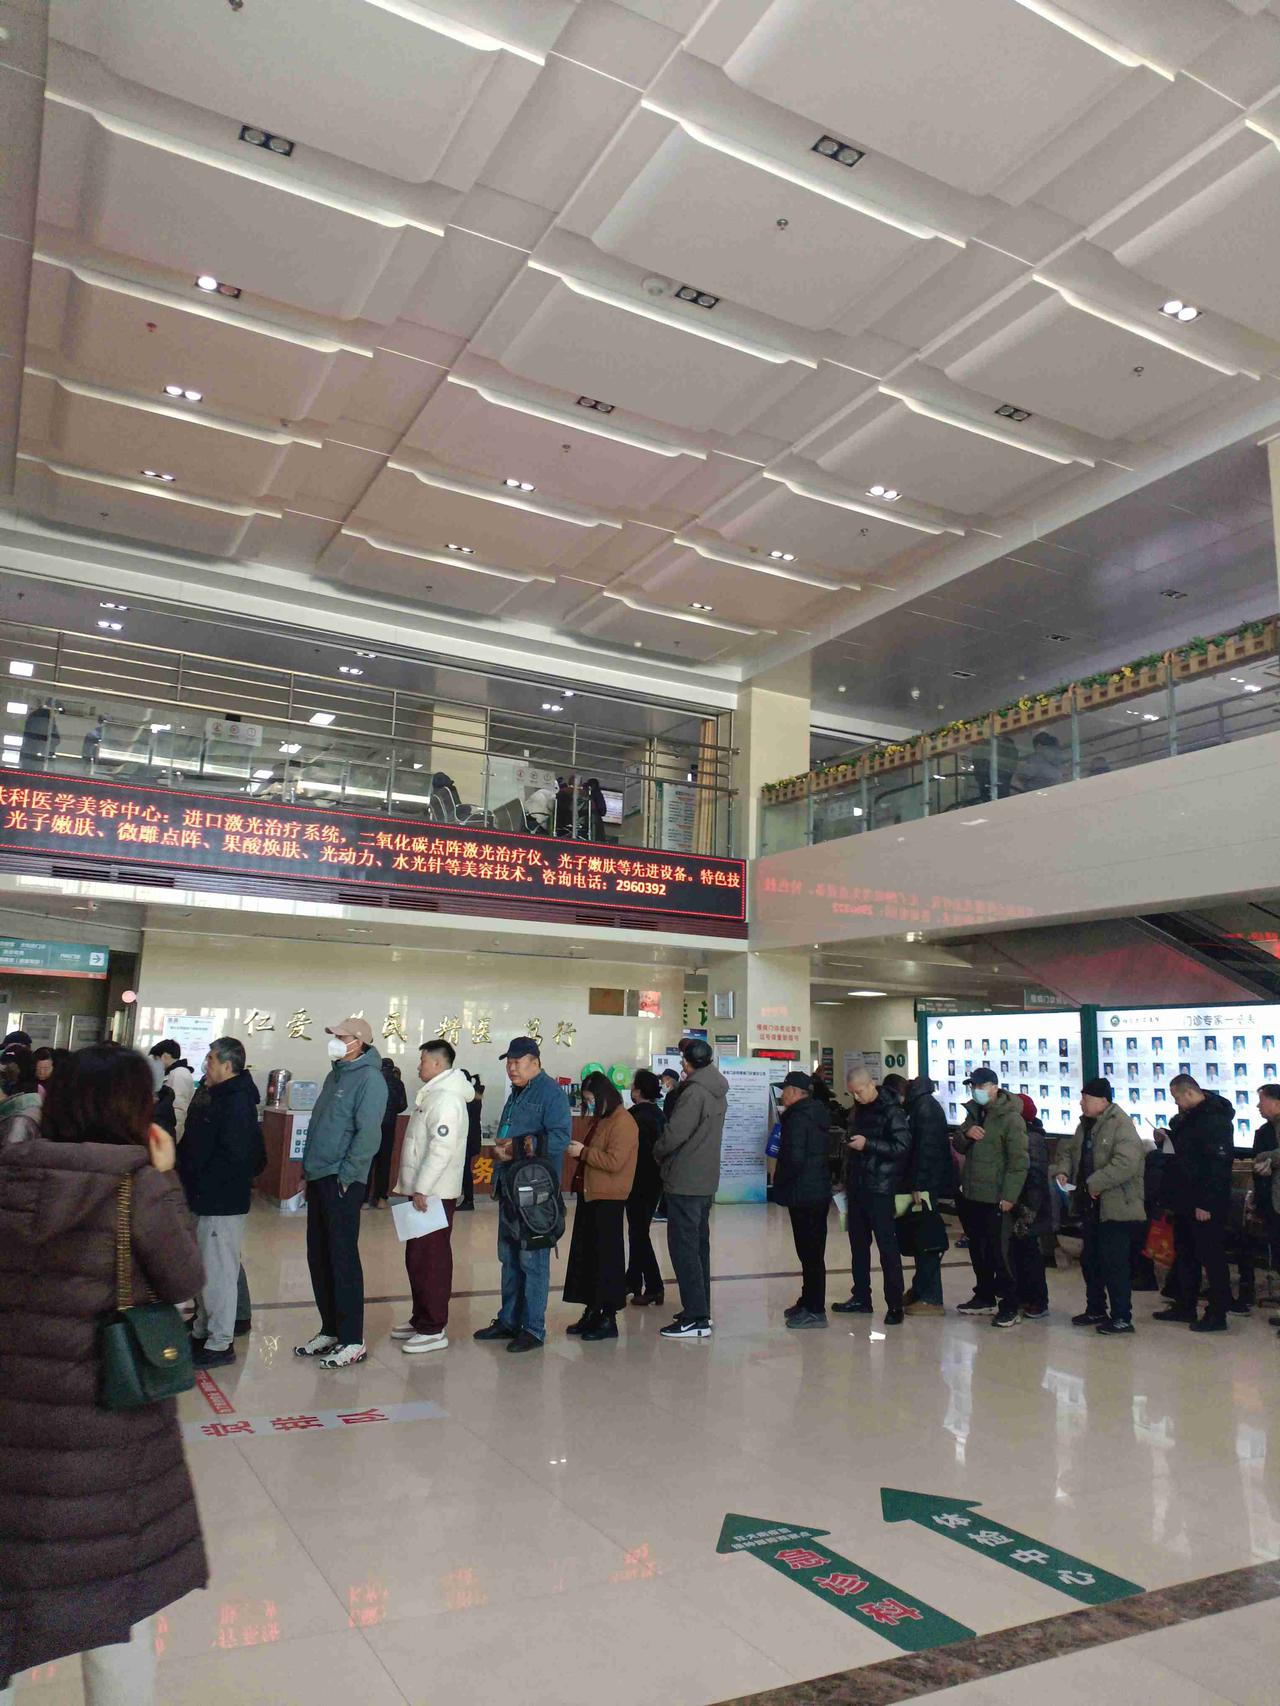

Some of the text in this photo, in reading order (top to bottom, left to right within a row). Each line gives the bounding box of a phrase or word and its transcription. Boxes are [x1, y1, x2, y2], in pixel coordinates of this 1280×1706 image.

[774, 1547, 925, 1627] 急诊科
[930, 1510, 1098, 1587] 体检中心
